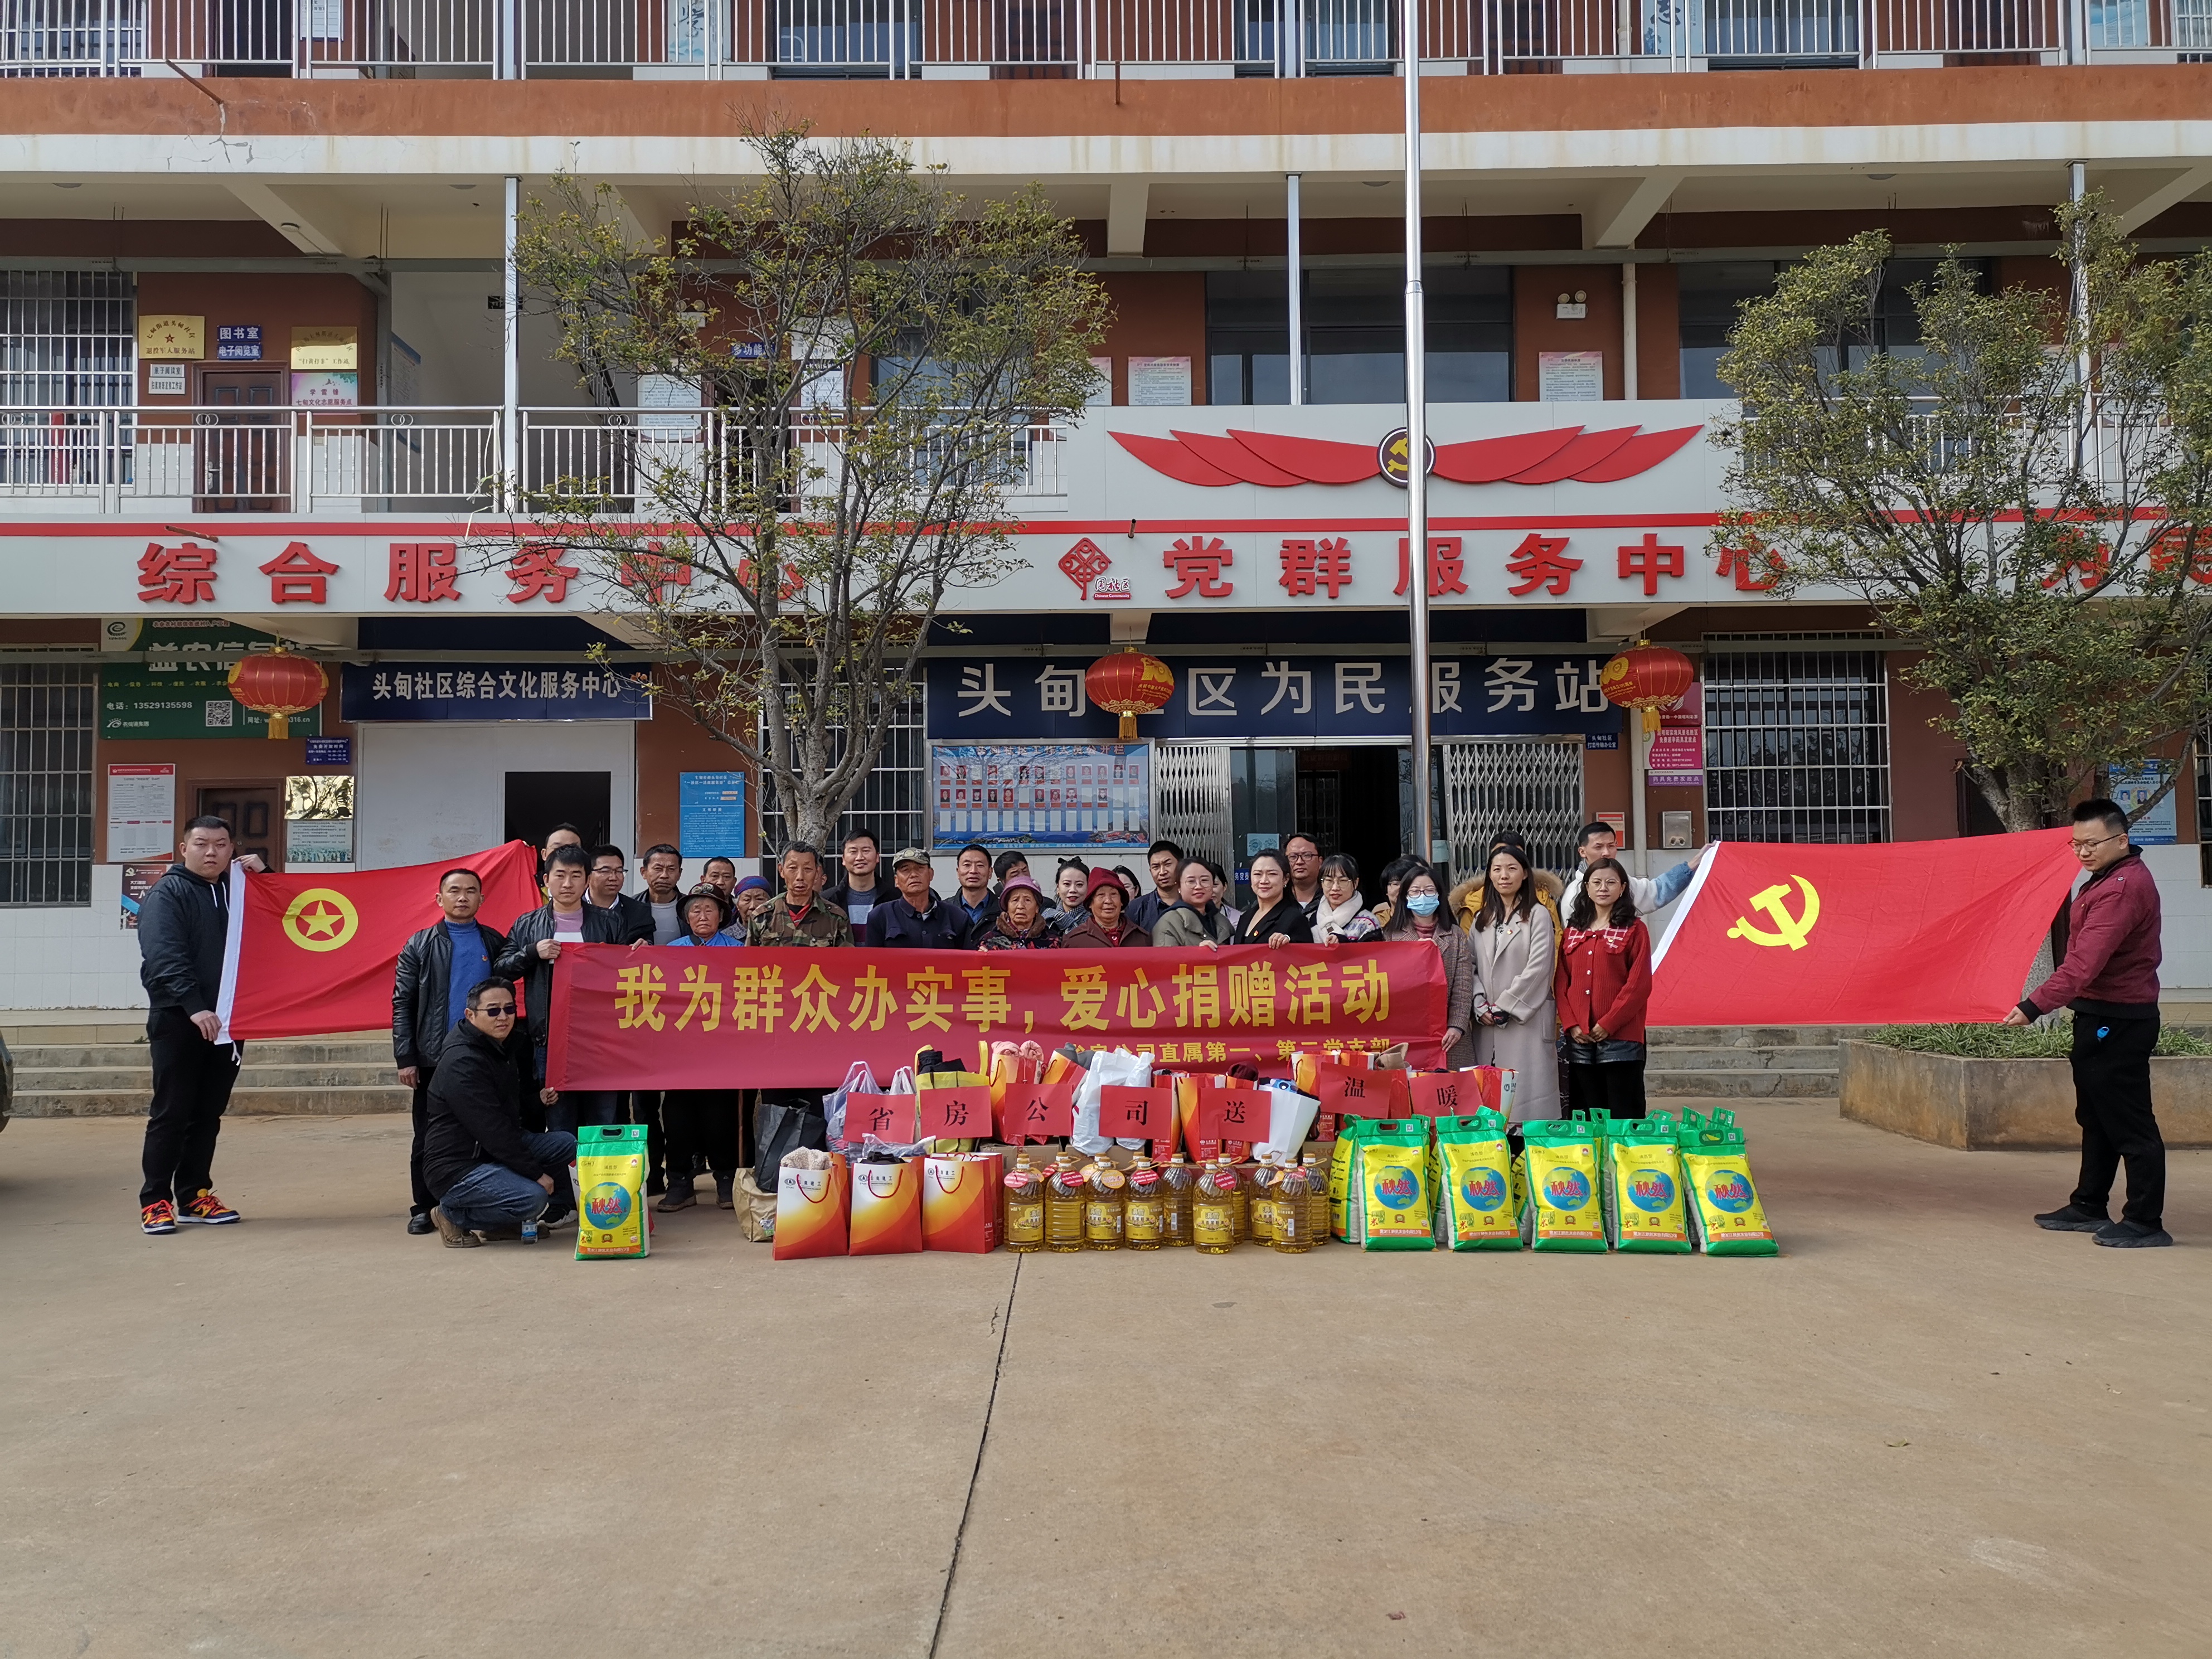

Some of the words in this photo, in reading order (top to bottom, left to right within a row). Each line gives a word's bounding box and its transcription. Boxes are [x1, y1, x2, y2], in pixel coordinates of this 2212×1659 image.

[220, 327, 259, 339] 图书室
[219, 345, 260, 357] 电子阅览室
[733, 343, 775, 356] 多功能
[372, 671, 622, 700] 头甸社区综合文化服务中心
[957, 658, 1608, 718] 头甸区为民服务站
[614, 959, 1389, 1034] 我为群众办实事，爱心捐赠活动
[869, 1107, 894, 1132] 省
[944, 1100, 969, 1127] 房
[1026, 1097, 1049, 1122] 公
[1126, 1100, 1148, 1126] 司
[1224, 1100, 1247, 1123] 送
[1345, 1076, 1366, 1098] 温
[1437, 1085, 1458, 1108] 暖
[1382, 1178, 1413, 1196] 秋然
[1468, 1179, 1500, 1196] 秋然
[1550, 1180, 1583, 1196] 秋然
[1634, 1180, 1667, 1198] 秋然
[1714, 1183, 1749, 1200] 秋然
[591, 1197, 623, 1215] 秋然
